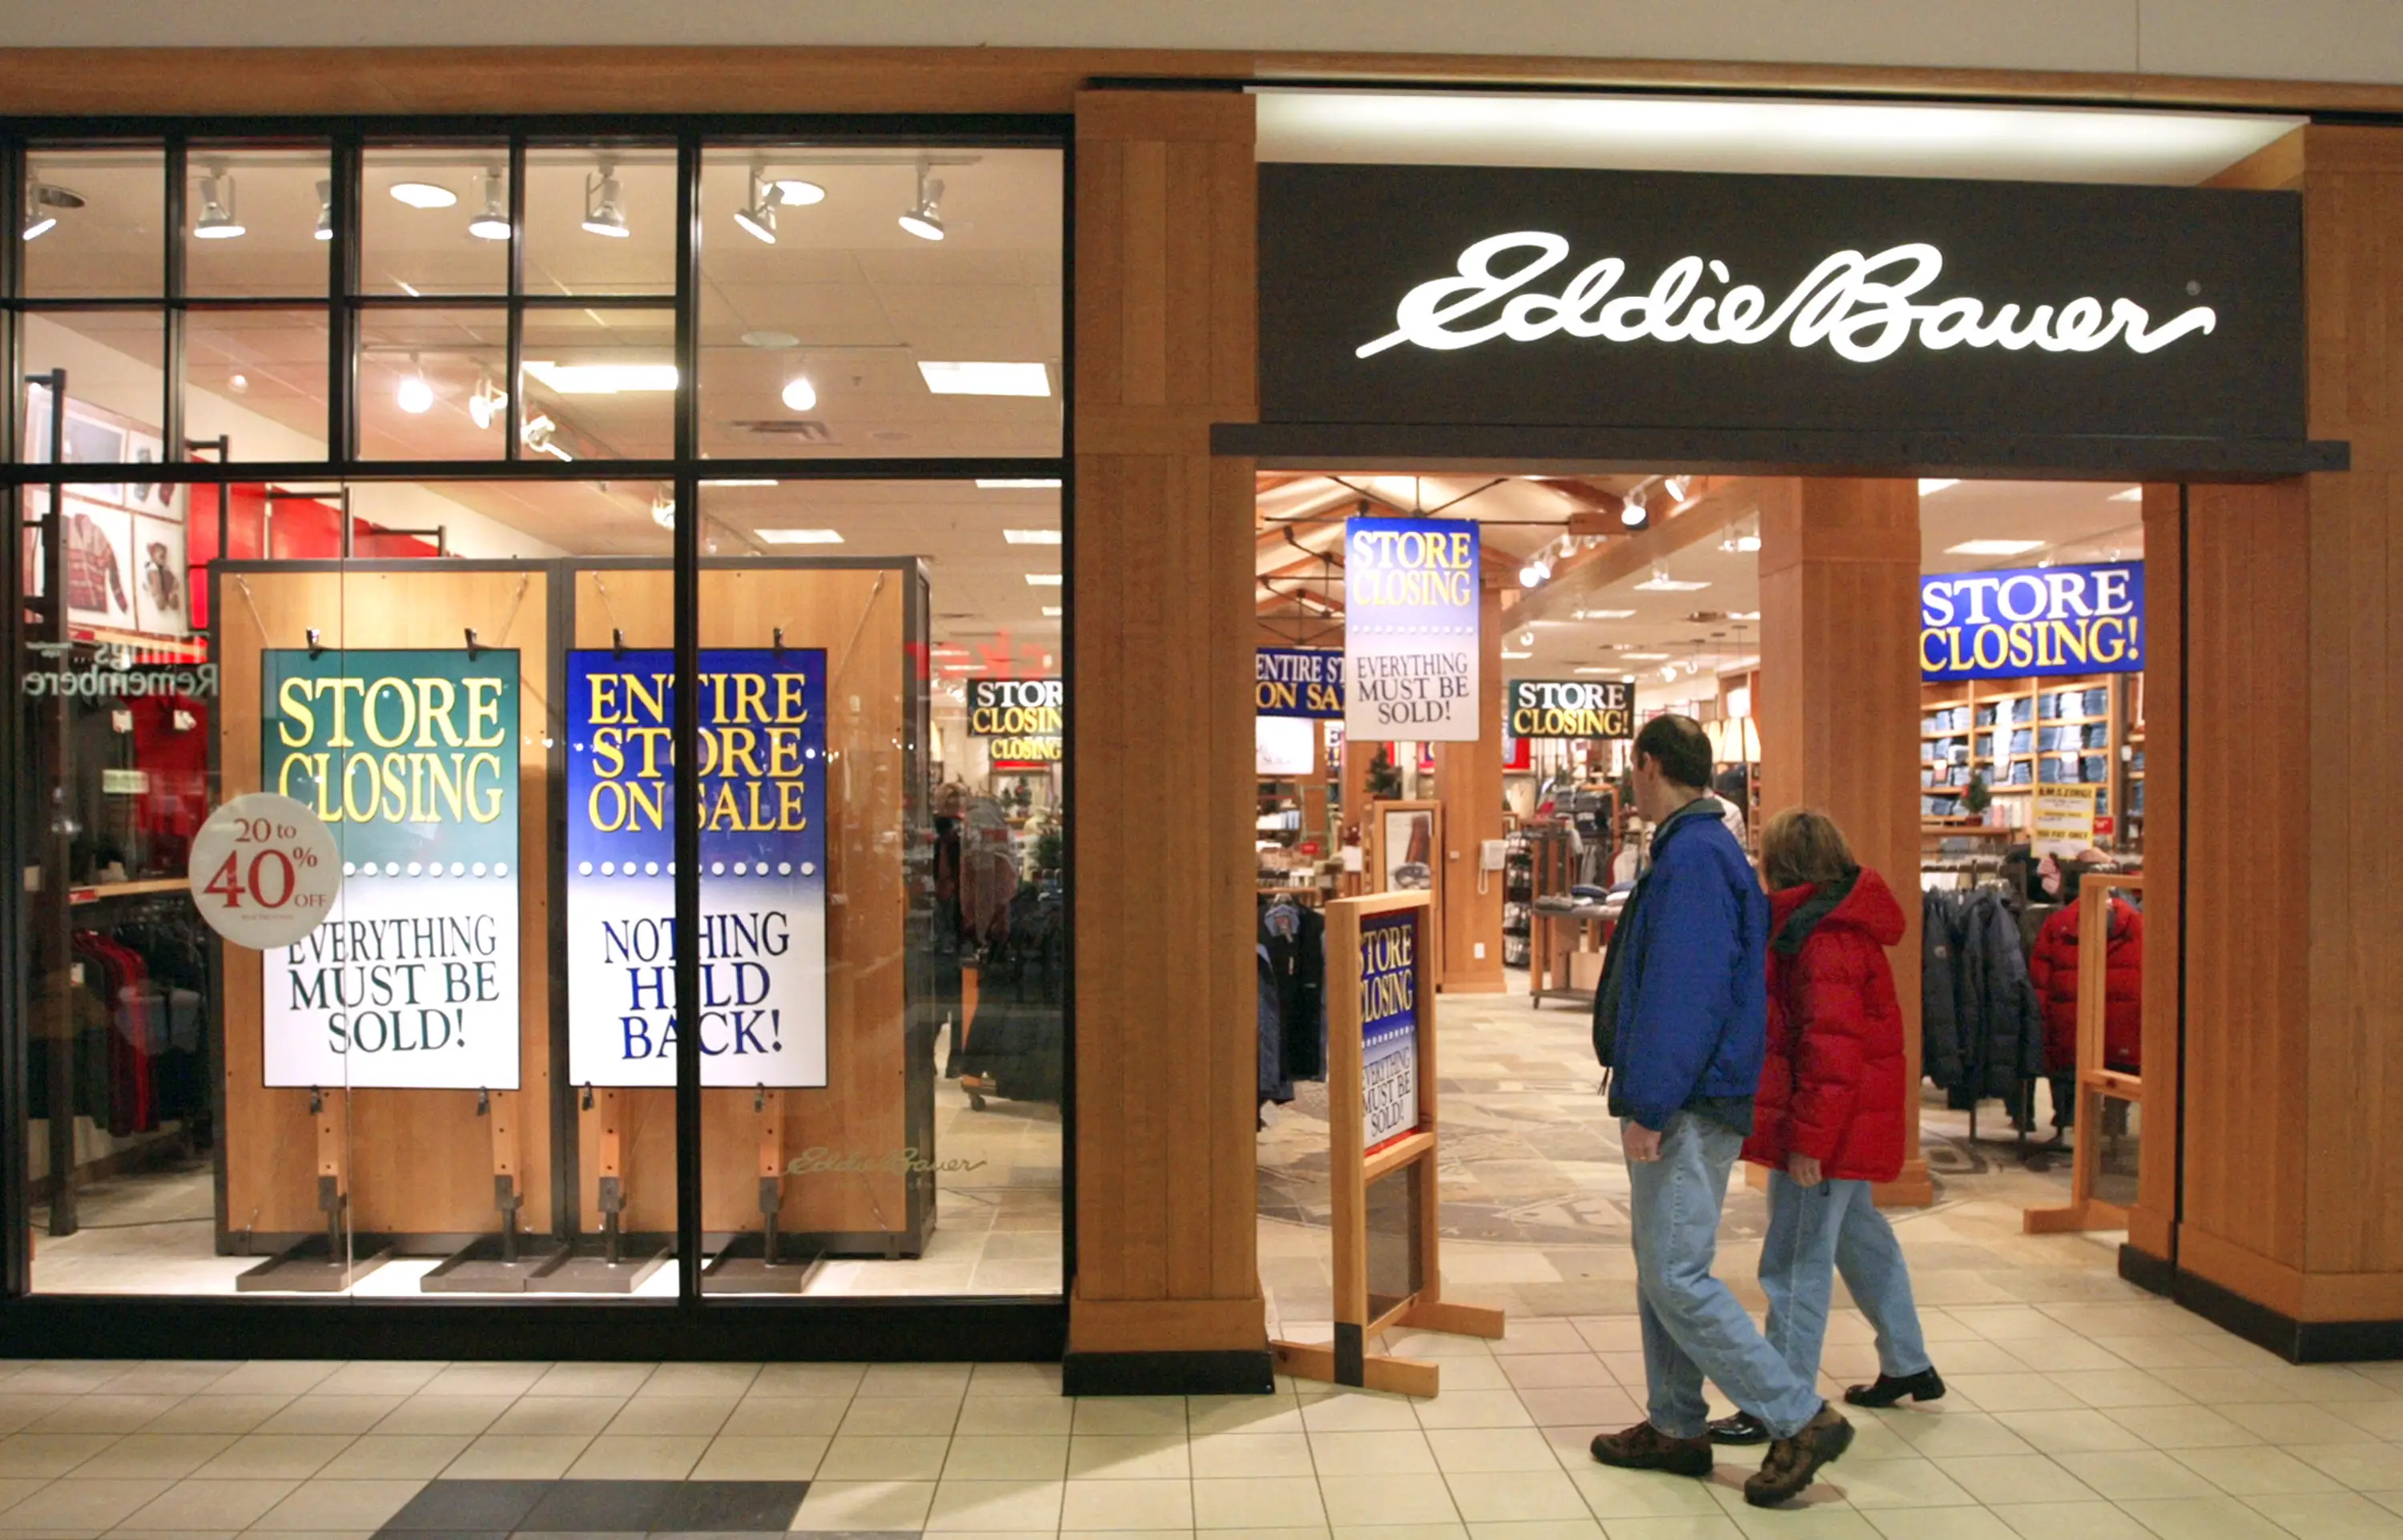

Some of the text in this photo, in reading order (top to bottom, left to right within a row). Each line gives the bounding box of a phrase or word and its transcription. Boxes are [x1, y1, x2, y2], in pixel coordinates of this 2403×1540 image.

[1355, 231, 2216, 363] Eddie Bauer
[1352, 530, 1472, 569] STORE
[1353, 569, 1471, 607] CLOSING
[1922, 569, 2134, 626] STORE
[1919, 616, 2139, 672] CLOSING!
[1256, 653, 1322, 682] ENTIRE
[1356, 653, 1468, 679] EVERYTHING
[586, 673, 807, 724] ENIRE
[977, 682, 1062, 707] STOR
[1256, 682, 1345, 711] ON SA
[1358, 676, 1469, 702] MUST BE
[1518, 682, 1627, 710] STORE
[279, 677, 505, 748] STORE
[972, 706, 1062, 734] CLOSIN
[1378, 700, 1451, 725] SOLD!
[1513, 708, 1629, 735] CLOSING!
[992, 738, 1062, 760] CLOSING
[278, 752, 504, 823] CLOSING
[589, 780, 666, 832] ON
[234, 818, 297, 842] 20 to
[294, 894, 326, 907] OFF
[288, 915, 496, 965] EVERYTHING
[288, 961, 500, 1010] MUST BE
[626, 962, 771, 1011] HLD
[328, 1008, 465, 1054] SOLD!
[1397, 1071, 1411, 1098] BE
[1371, 1099, 1404, 1137] SOLD!
